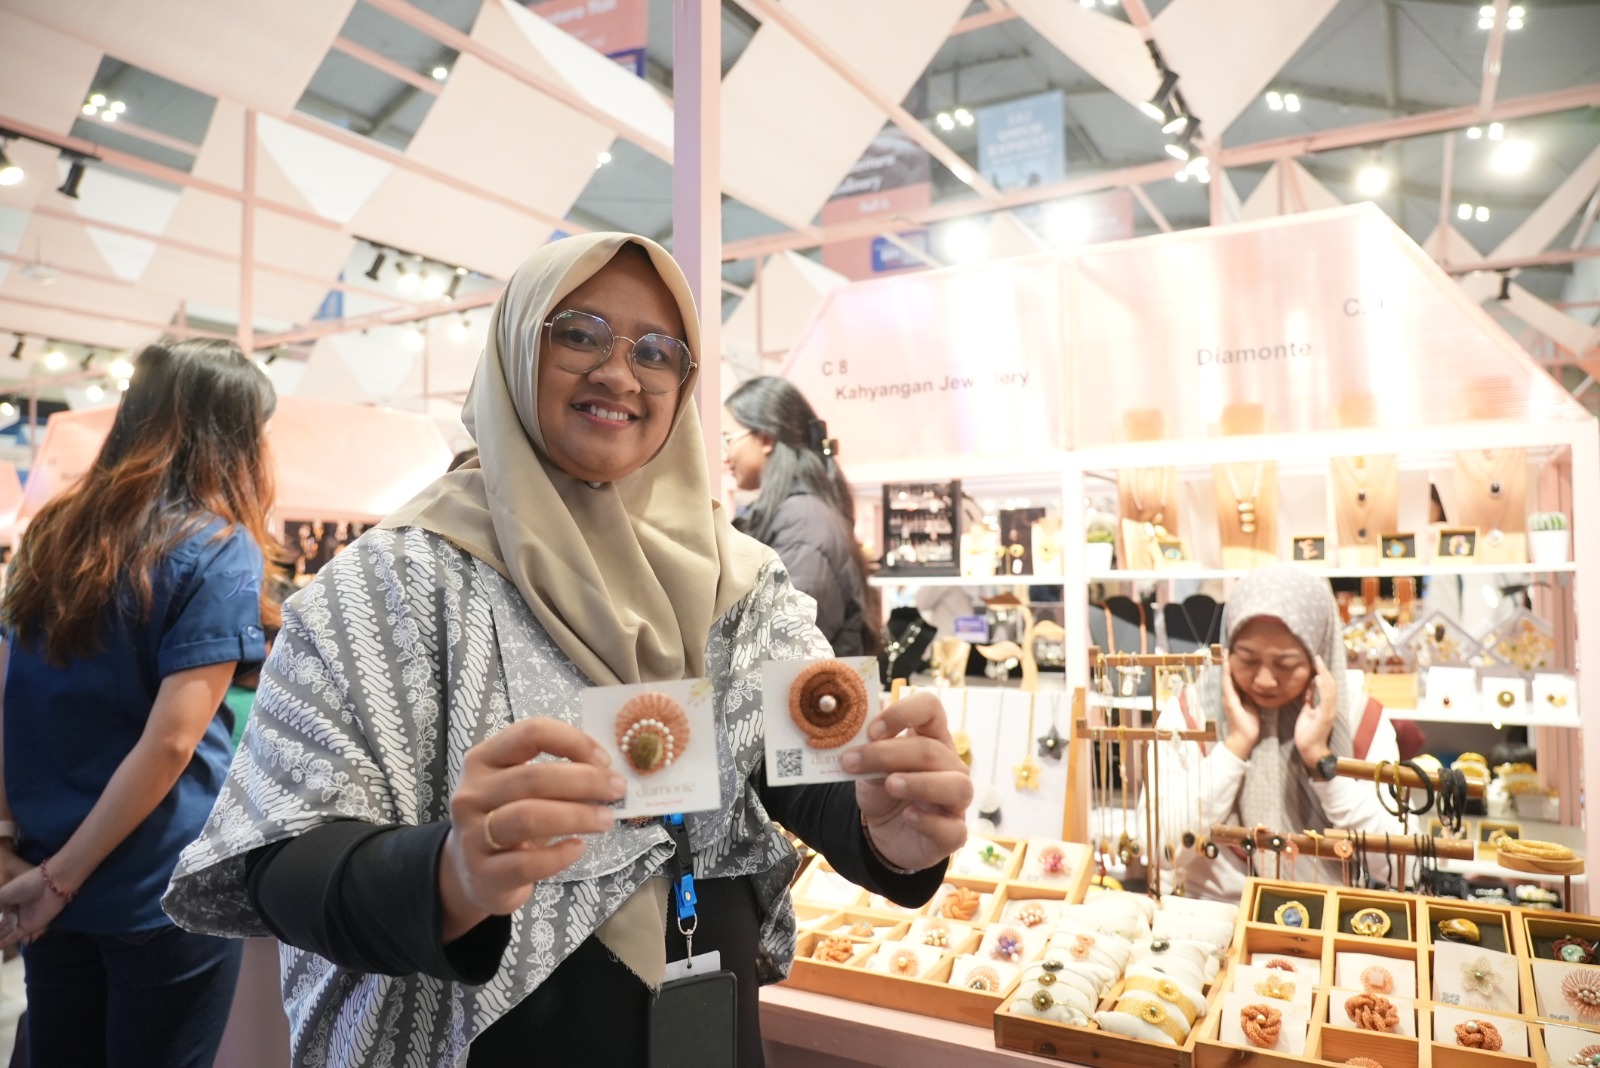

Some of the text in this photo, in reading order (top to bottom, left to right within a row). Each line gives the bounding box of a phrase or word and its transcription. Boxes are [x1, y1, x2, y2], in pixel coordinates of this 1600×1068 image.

[1197, 342, 1312, 366] Diamonte
[821, 359, 849, 376] C 8
[835, 370, 1030, 401] Kahyangan Jewlery
[811, 752, 842, 765] diam
[635, 781, 697, 799] diamonte
